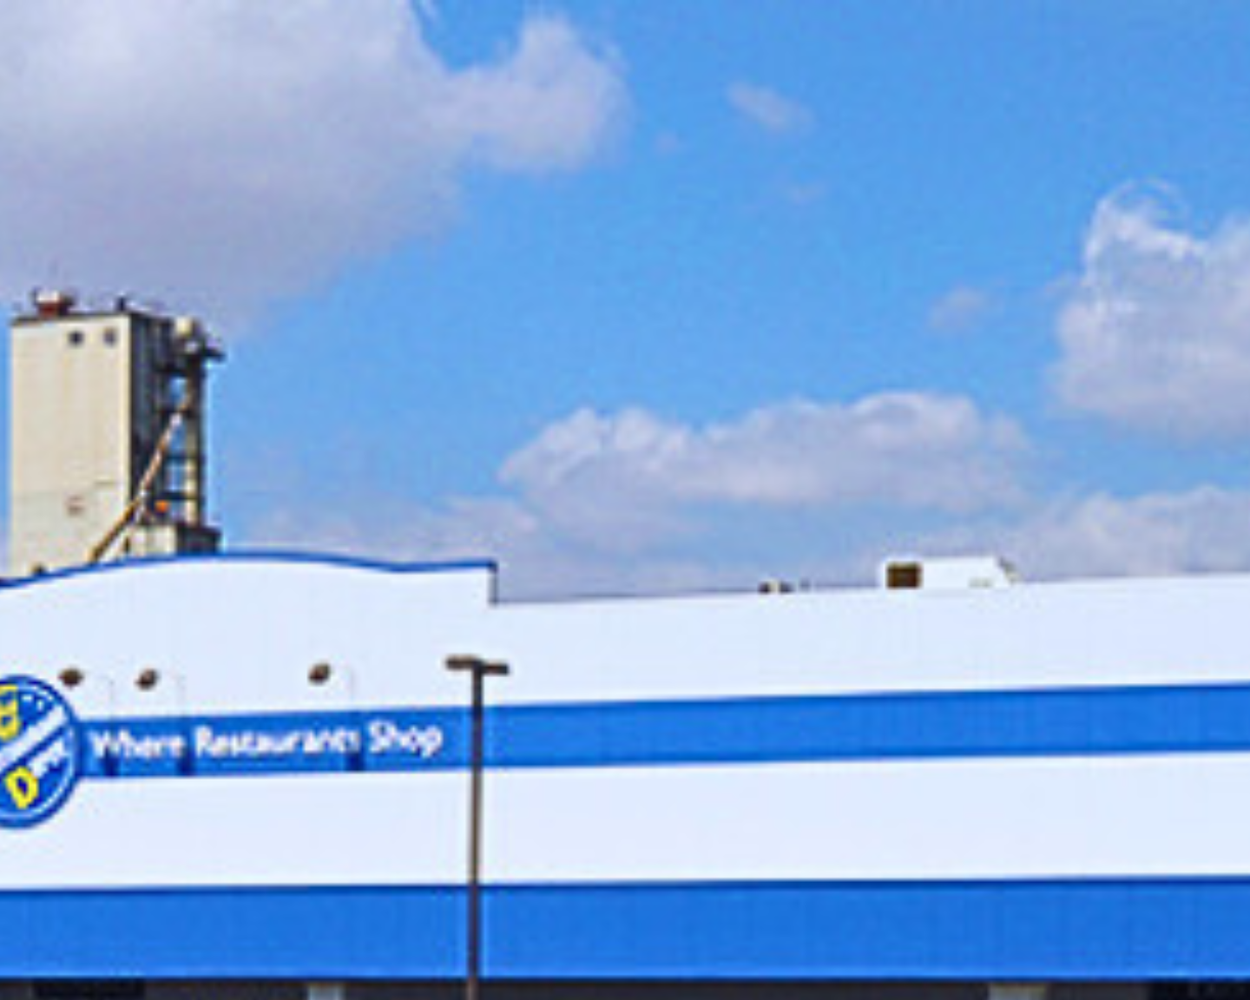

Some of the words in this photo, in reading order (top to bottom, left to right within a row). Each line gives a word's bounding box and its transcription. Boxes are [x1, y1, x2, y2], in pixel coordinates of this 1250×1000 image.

[89, 728, 185, 758] Where
[195, 725, 362, 758] Restaurants
[368, 719, 444, 758] Shop
